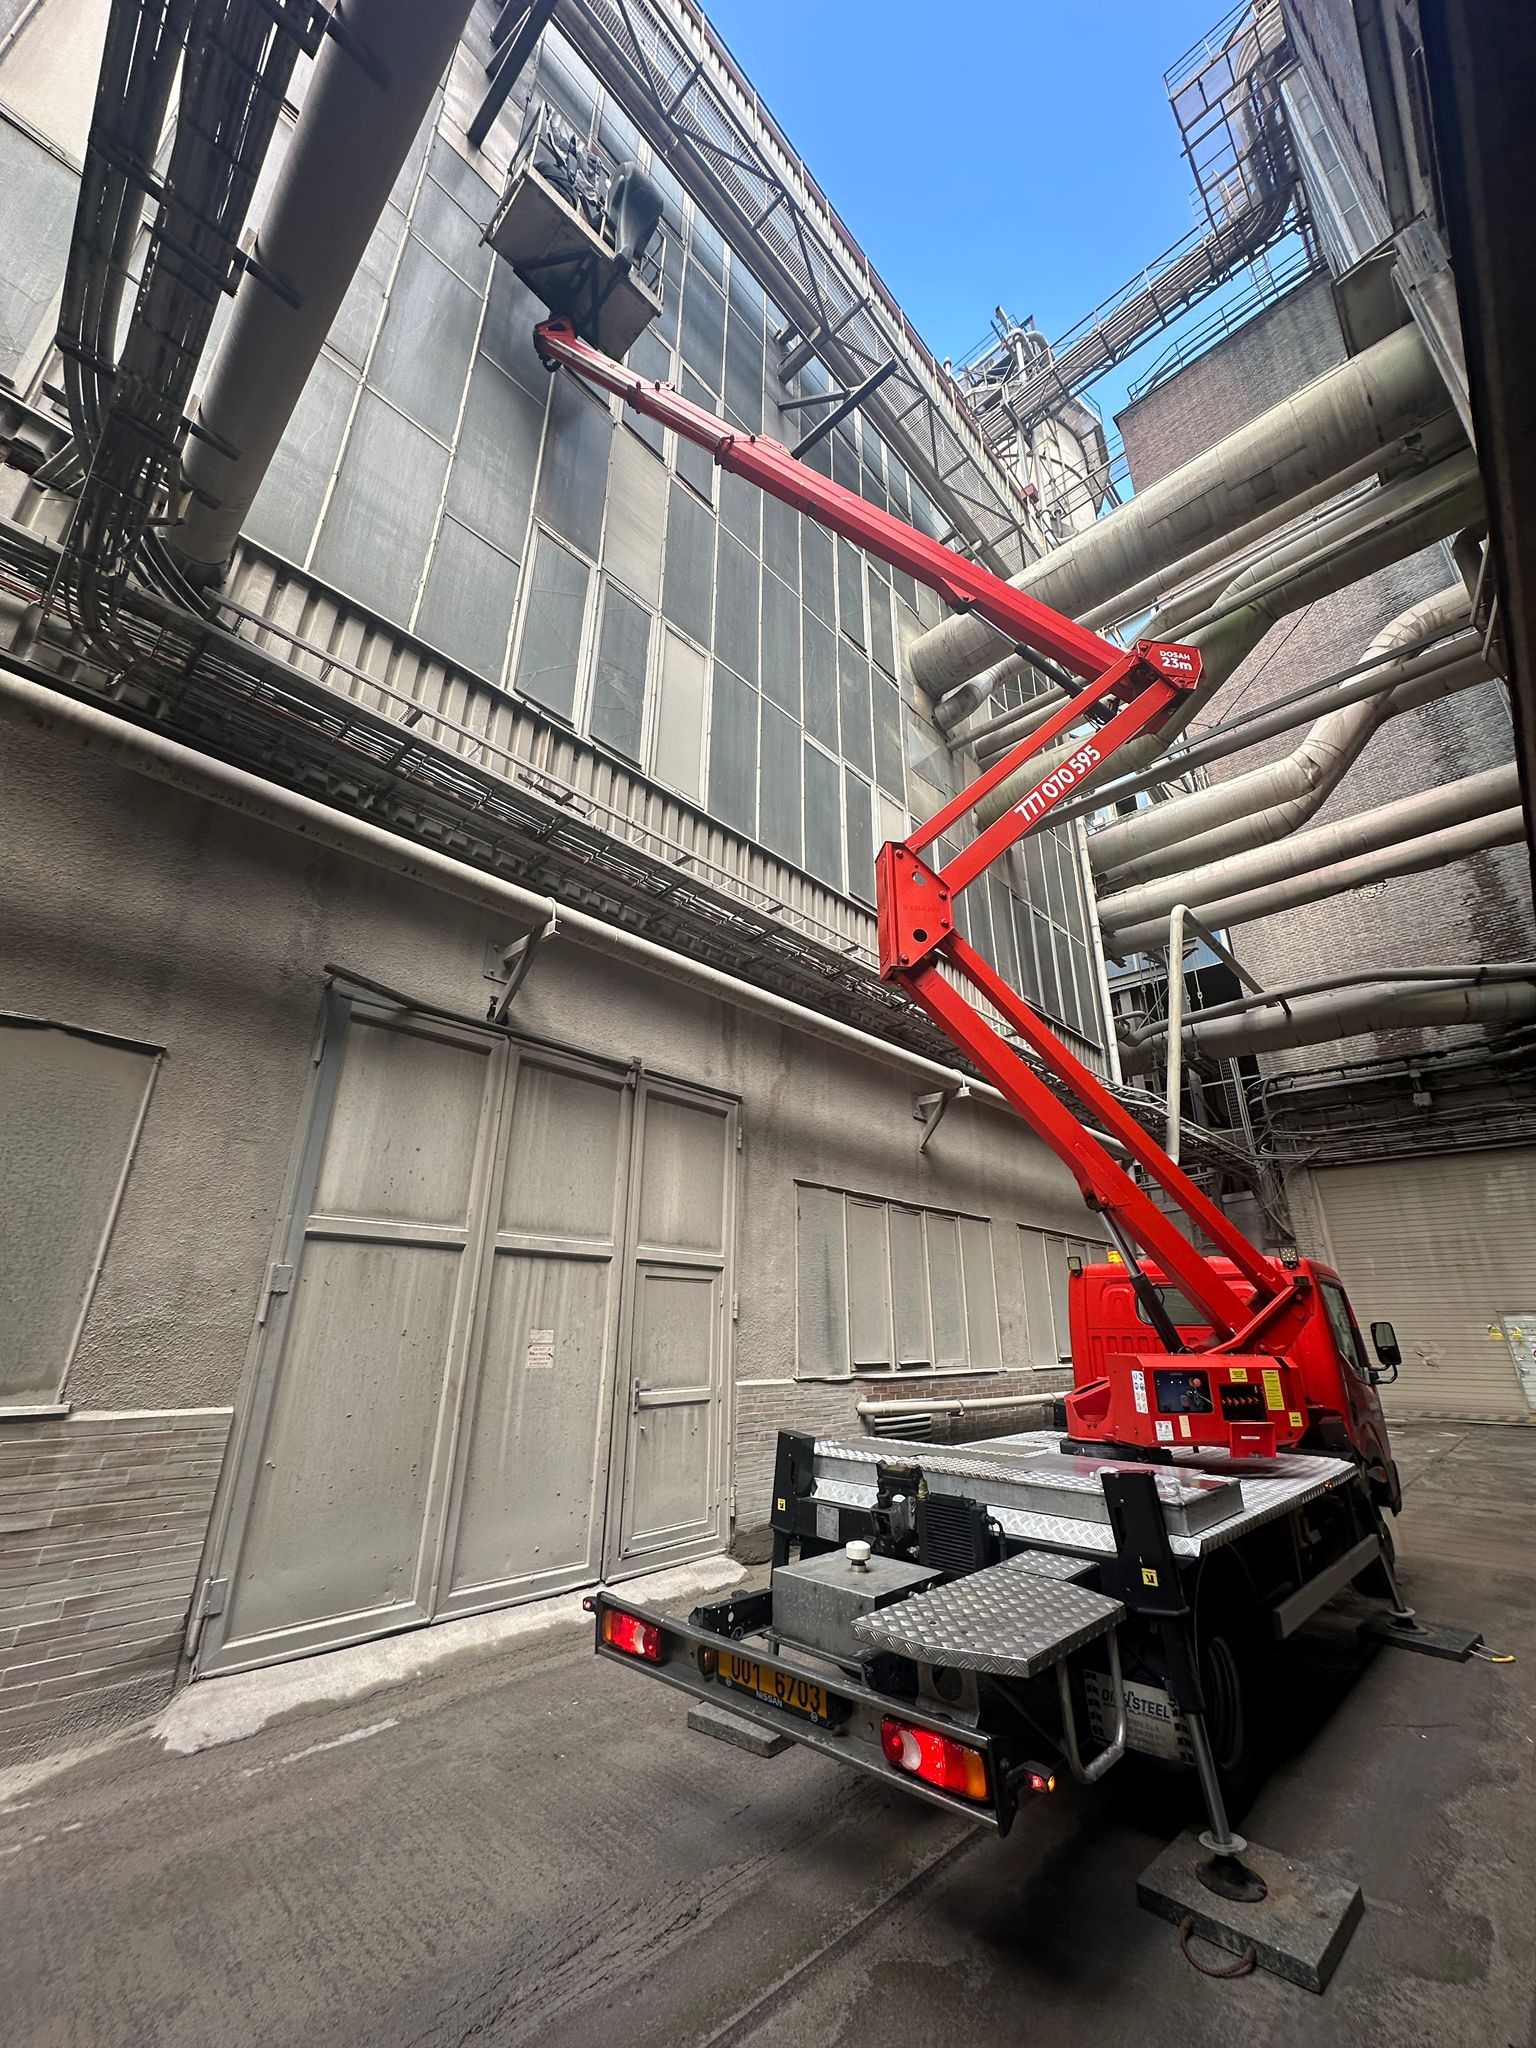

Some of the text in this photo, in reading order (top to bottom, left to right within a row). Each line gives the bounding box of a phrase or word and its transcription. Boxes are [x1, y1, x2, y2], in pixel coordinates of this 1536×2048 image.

[1161, 656, 1193, 671] 23m
[1013, 744, 1101, 821] 777 070 595
[755, 1689, 783, 1708] NISSAN
[775, 1671, 820, 1712] 6703
